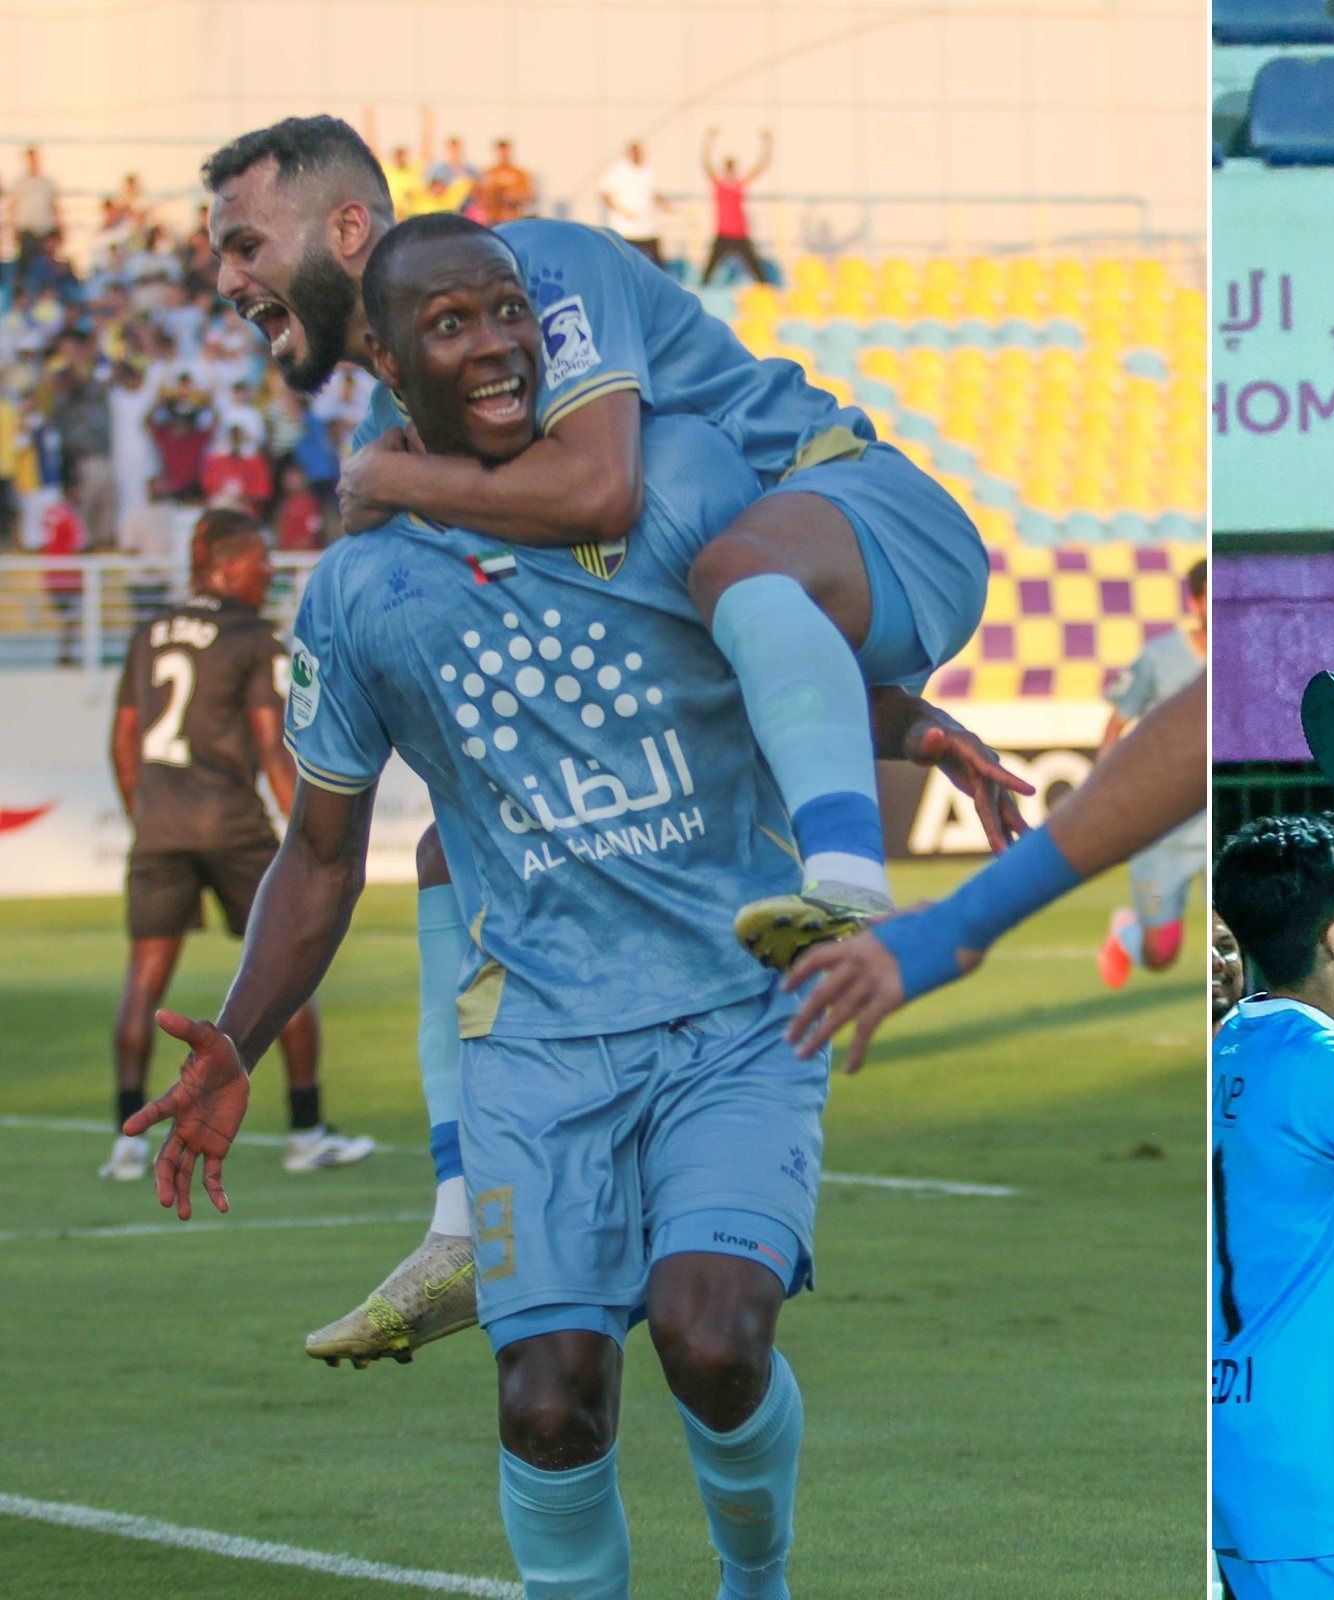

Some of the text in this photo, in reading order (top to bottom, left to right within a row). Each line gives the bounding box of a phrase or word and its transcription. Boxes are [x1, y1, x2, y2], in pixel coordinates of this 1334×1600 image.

[142, 648, 193, 768] 2
[523, 806, 706, 880] AL HANNAH
